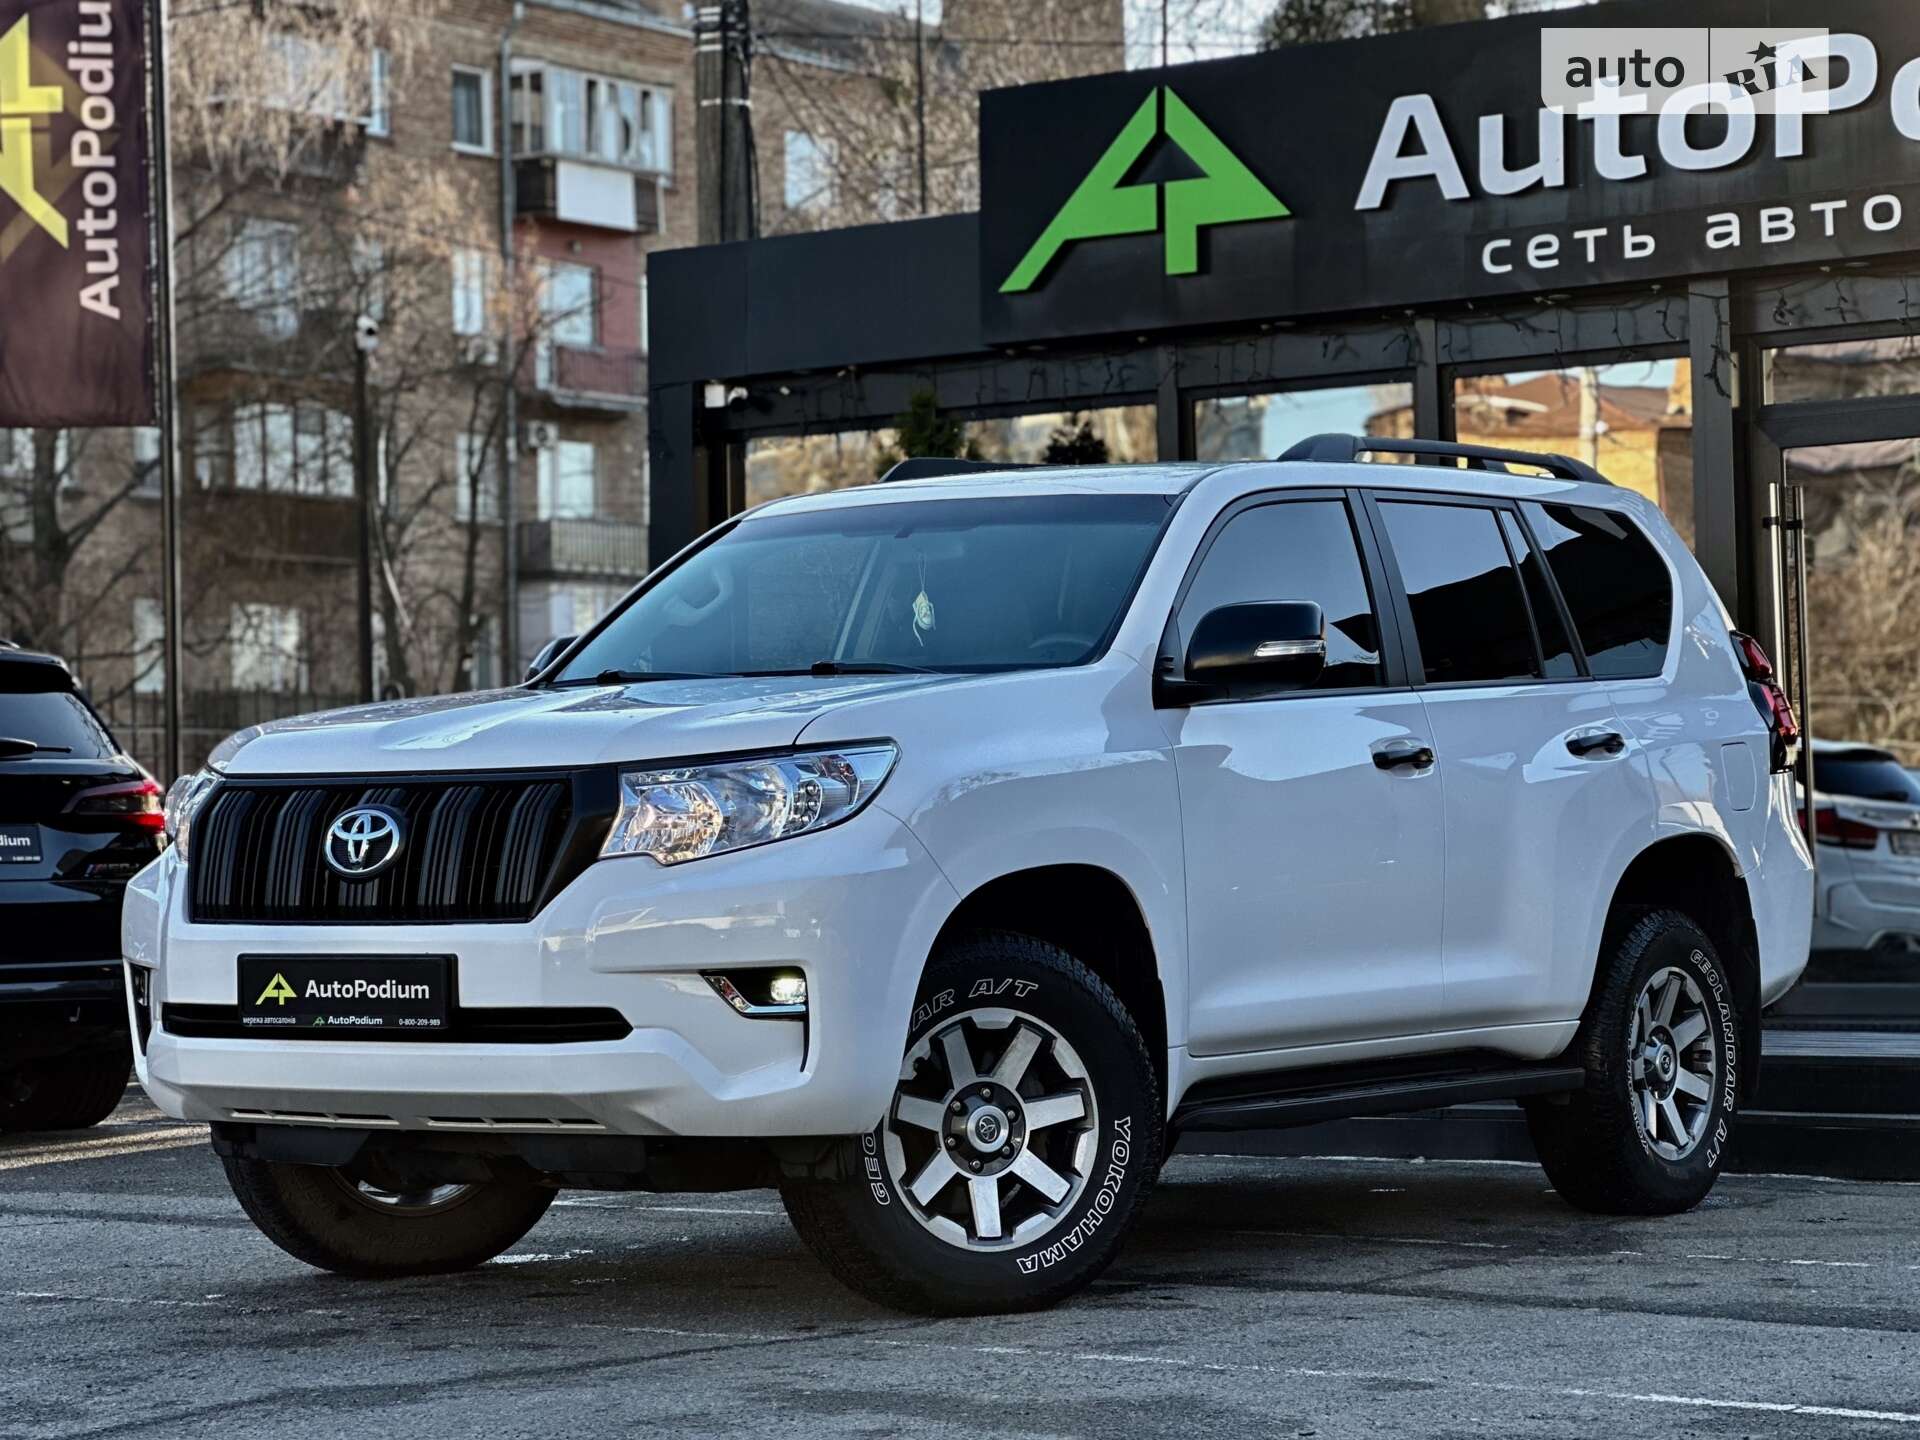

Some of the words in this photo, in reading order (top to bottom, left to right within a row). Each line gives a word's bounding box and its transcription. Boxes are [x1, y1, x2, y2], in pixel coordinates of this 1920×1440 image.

[1482, 224, 1656, 274] сеть
[1705, 193, 1902, 250] авто
[304, 979, 430, 1000] AutoPodium
[967, 977, 1040, 998] A/T
[327, 1015, 383, 1026] AutoPodium
[1690, 949, 1737, 1112] GEOLANDAR
[1016, 1116, 1132, 1275] YOKOHAMA
